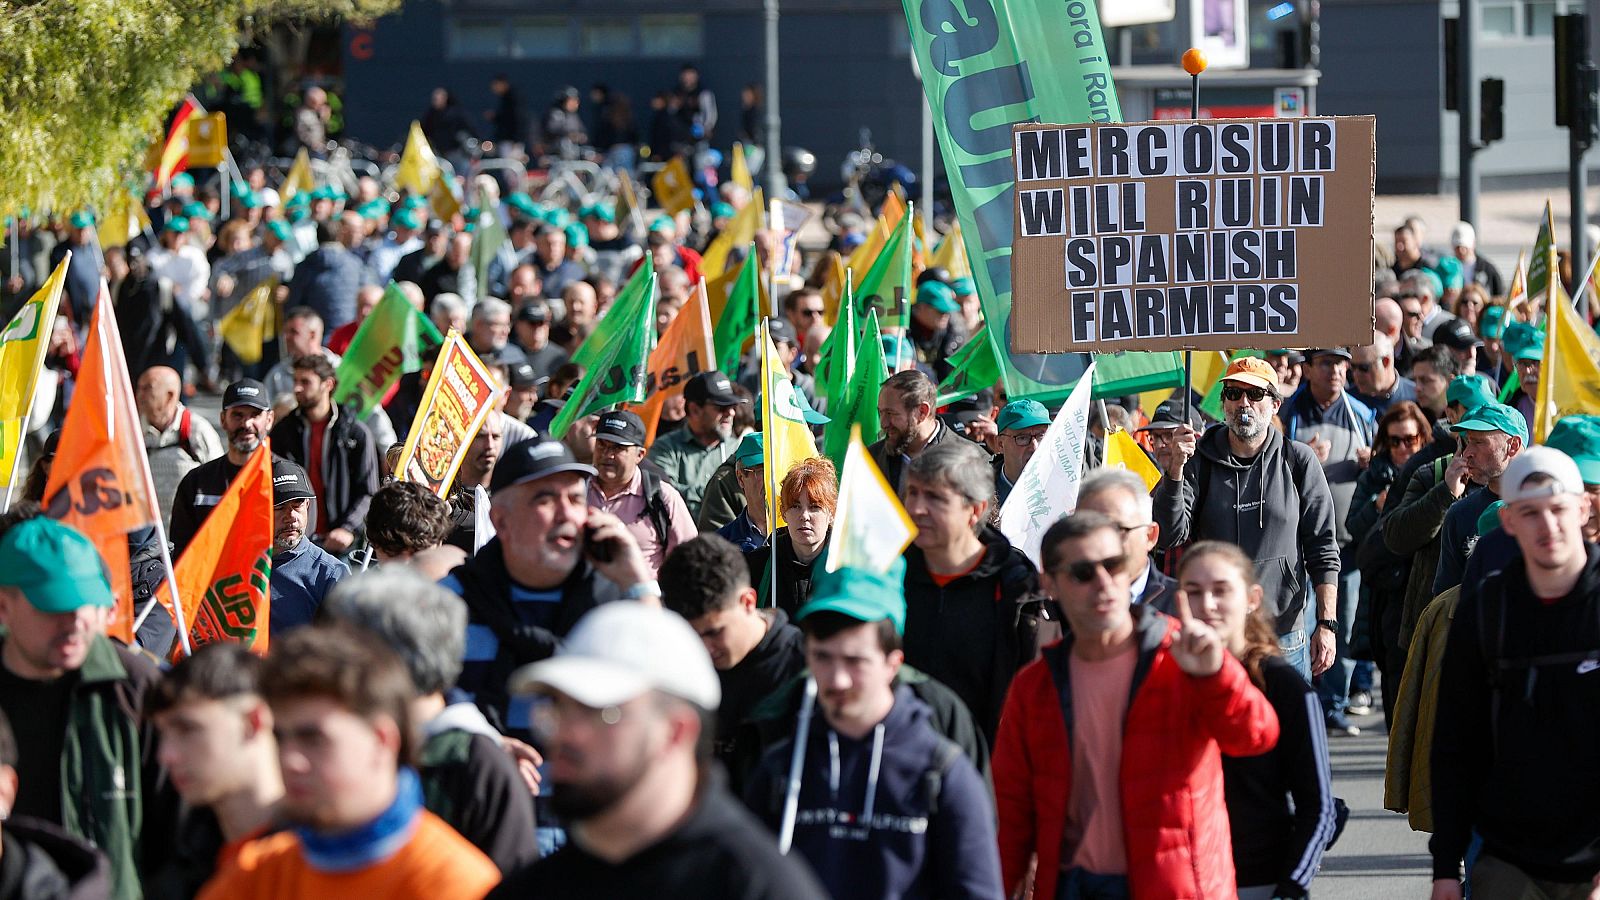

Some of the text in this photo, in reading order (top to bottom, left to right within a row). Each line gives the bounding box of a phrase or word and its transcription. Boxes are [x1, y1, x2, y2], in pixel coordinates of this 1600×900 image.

[1079, 56, 1103, 64] i
[1019, 122, 1332, 180] MERCOSUR
[1020, 176, 1322, 235] WILL RUIN
[1068, 229, 1296, 287] SPANISH
[1073, 284, 1297, 342] FARMERS
